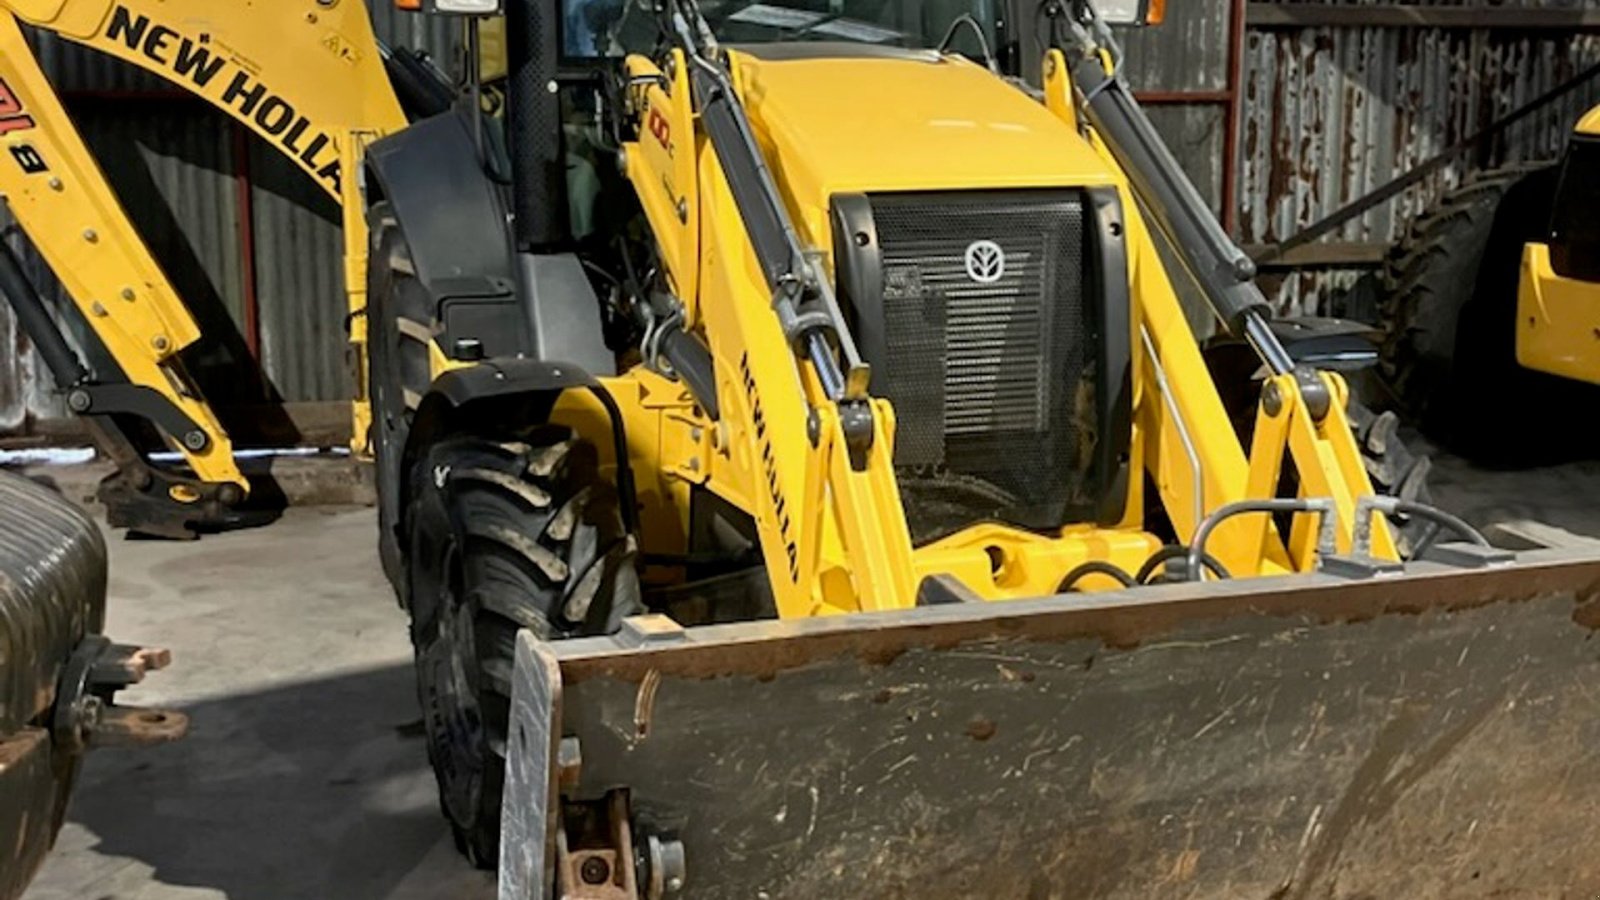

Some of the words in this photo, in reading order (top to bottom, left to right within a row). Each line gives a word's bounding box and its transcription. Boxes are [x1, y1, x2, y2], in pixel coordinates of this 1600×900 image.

[105, 4, 226, 87] NEW
[220, 70, 342, 195] HOLLA
[740, 349, 766, 439] NEW
